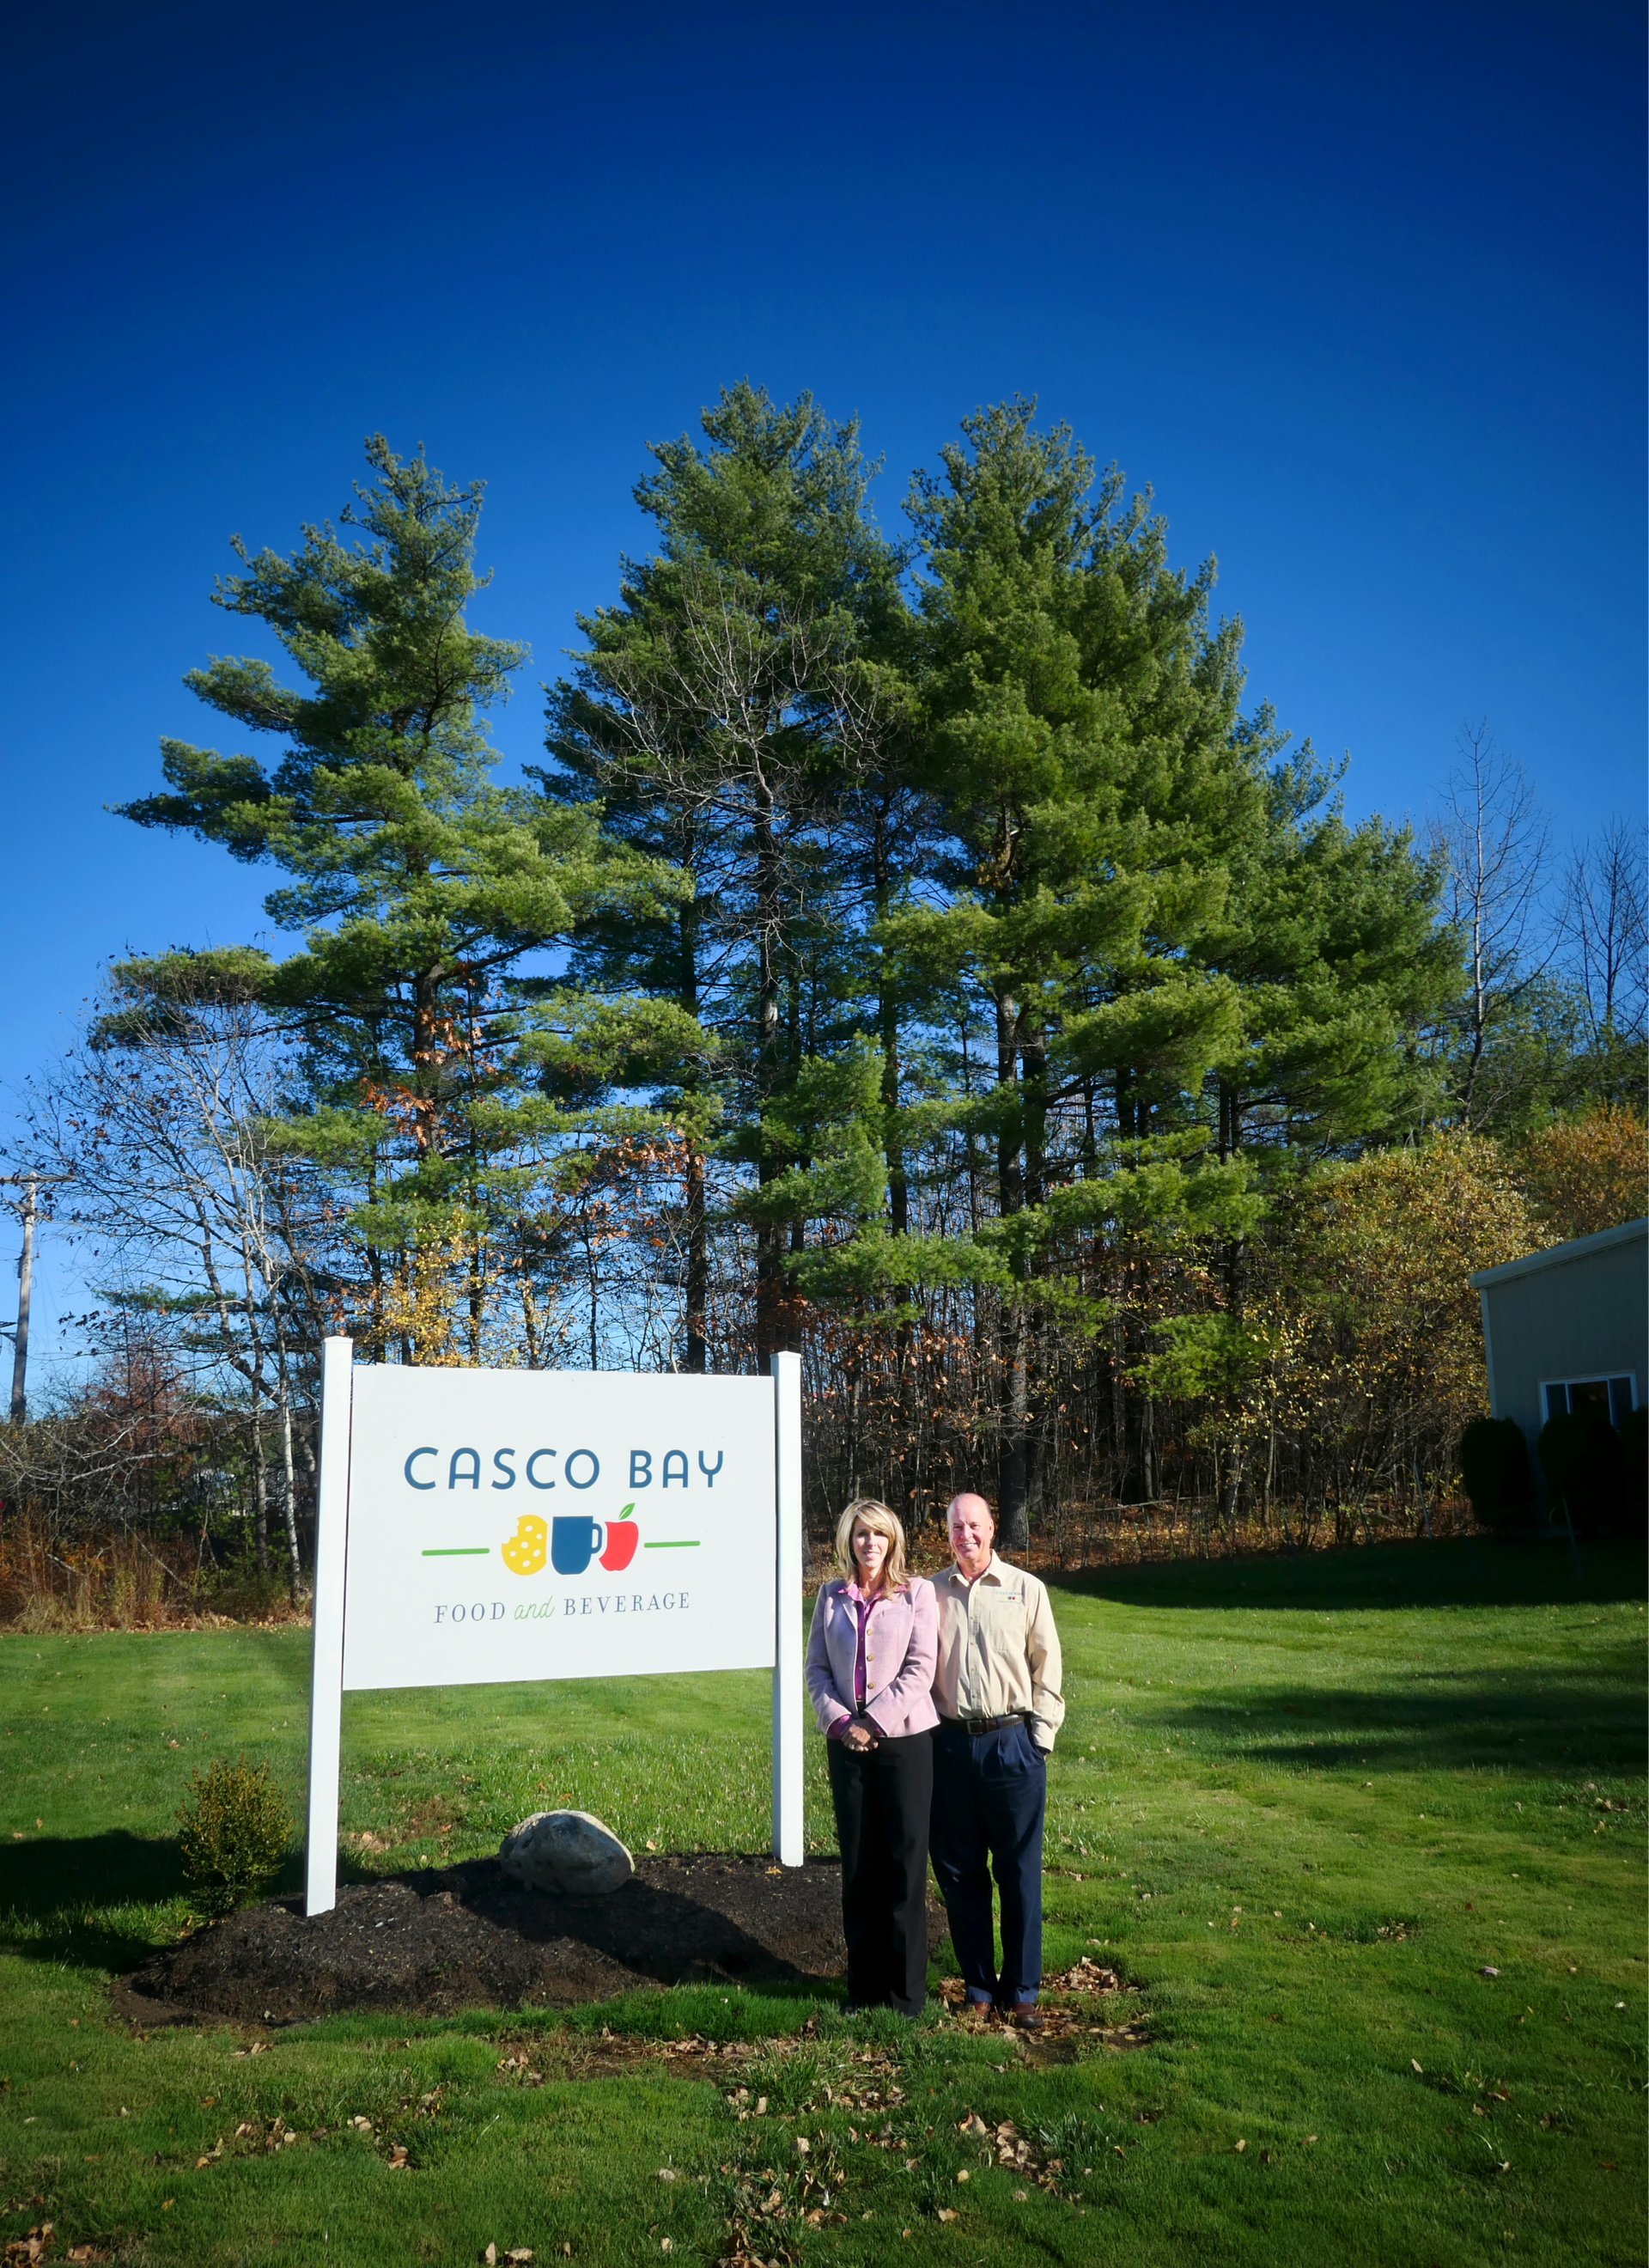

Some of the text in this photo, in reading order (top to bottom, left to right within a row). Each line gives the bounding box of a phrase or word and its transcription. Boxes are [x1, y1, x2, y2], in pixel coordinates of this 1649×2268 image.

[405, 1446, 723, 1491] CASCO BAY
[434, 1592, 690, 1624] FOOD and BEVERAGE
